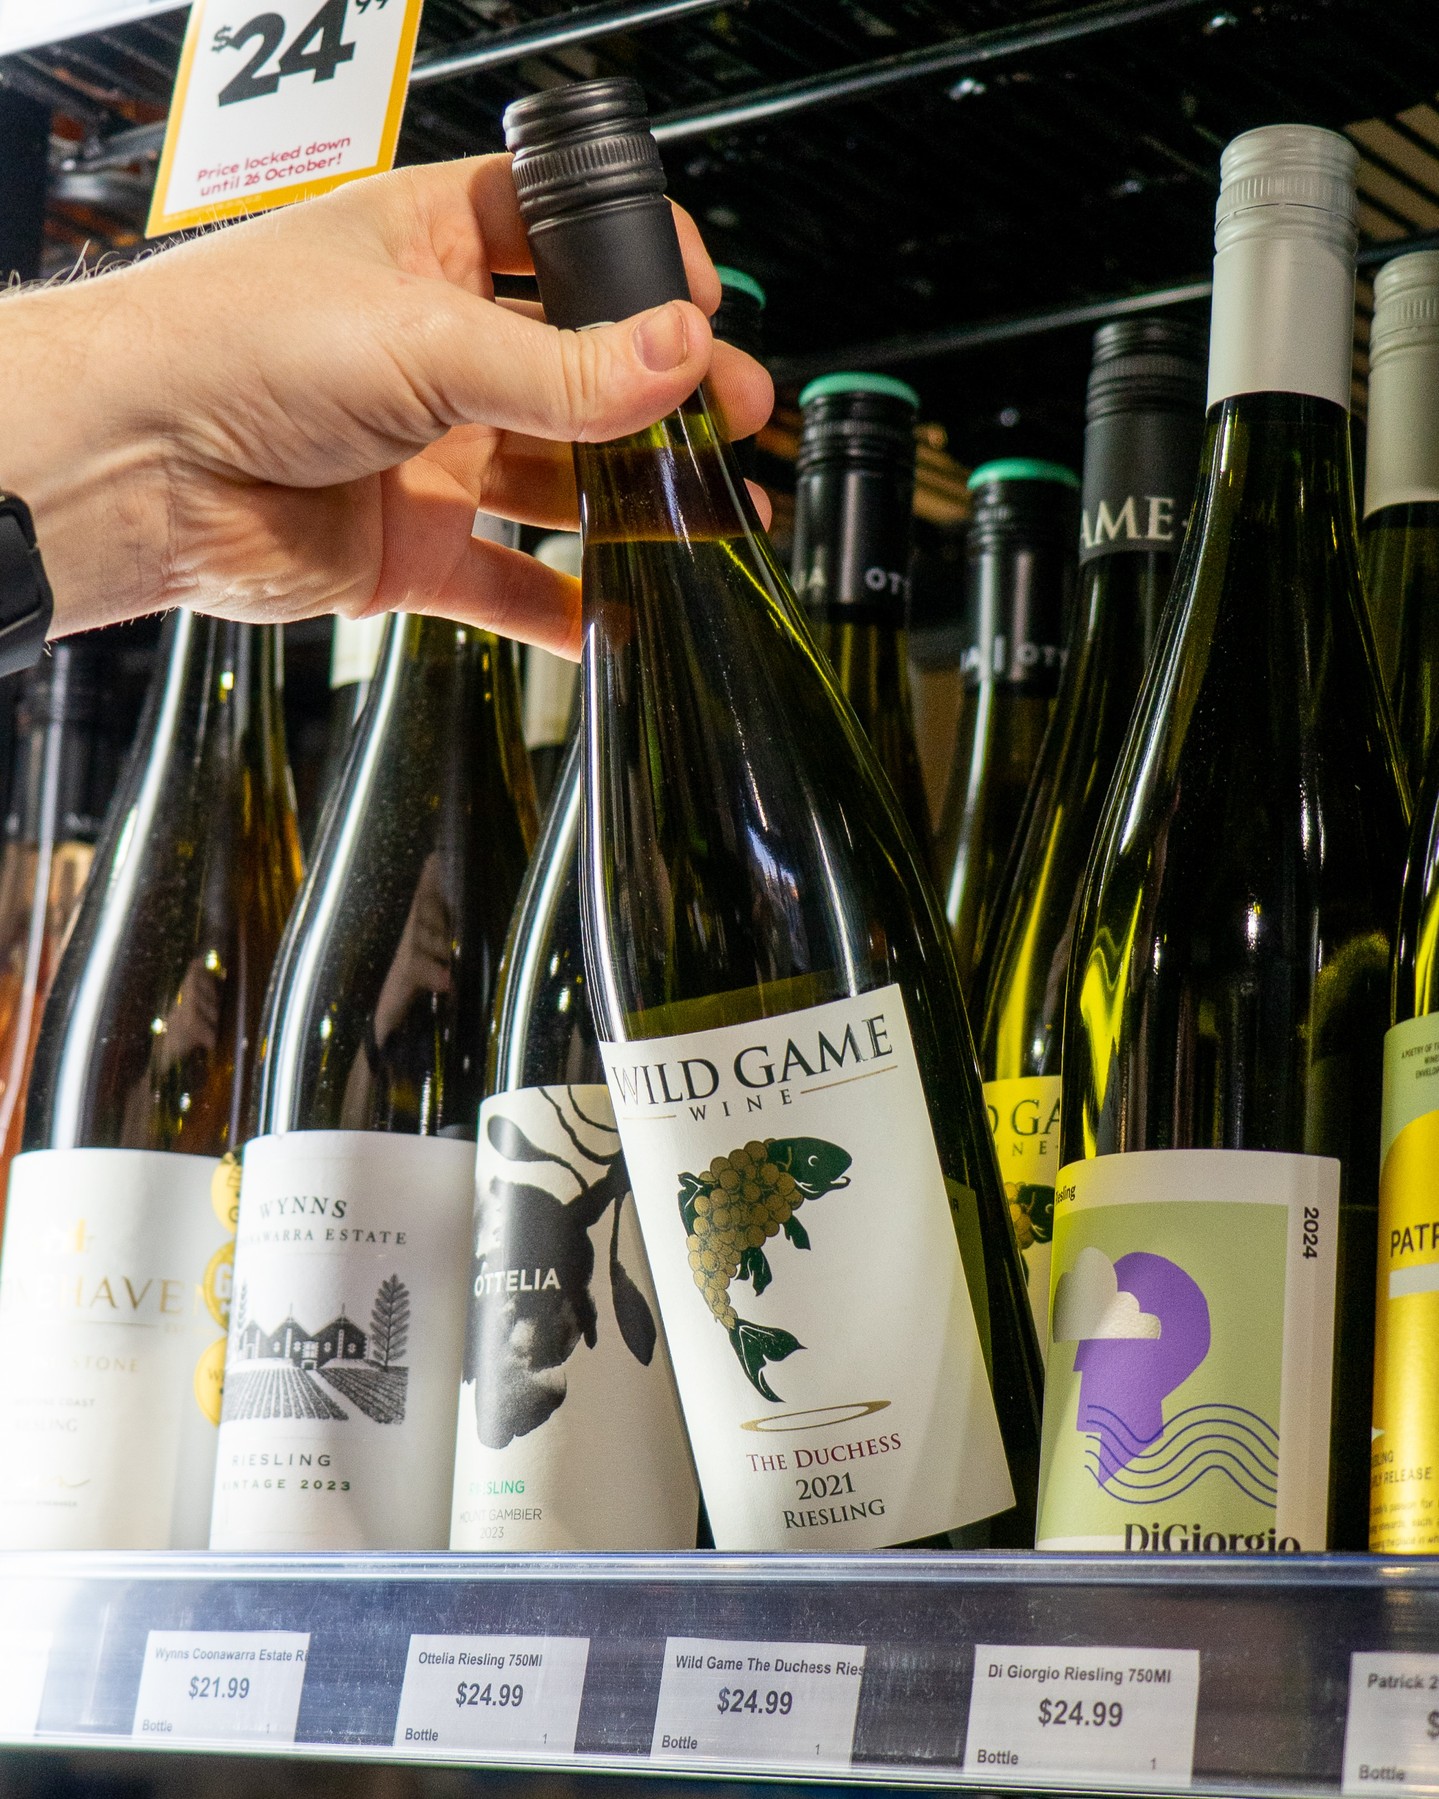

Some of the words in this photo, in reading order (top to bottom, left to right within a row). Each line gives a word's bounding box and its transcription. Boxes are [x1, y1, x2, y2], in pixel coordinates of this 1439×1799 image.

[197, 163, 239, 182] Price
[245, 146, 302, 171] locked
[305, 136, 351, 156] down
[201, 176, 240, 197] until
[244, 170, 260, 187] 26
[265, 152, 342, 182] October!
[611, 1058, 719, 1106] WILD
[733, 1014, 893, 1089] GAME
[689, 1088, 793, 1122] WINE
[259, 1196, 347, 1219] WYNNS
[326, 1228, 407, 1245] ESTATE
[1302, 1206, 1319, 1261] 2024
[474, 1268, 561, 1297] OTTELIA
[232, 1454, 331, 1467] RIESLING
[300, 1479, 351, 1492] 2023
[796, 1472, 856, 1500] 2021
[488, 1508, 542, 1521] GAMBIER
[480, 1526, 504, 1540] 2023
[155, 1648, 189, 1662] Wynns
[192, 1648, 256, 1661] Coonawarra
[259, 1649, 293, 1661] Estate
[418, 1651, 455, 1665] Ottelia
[458, 1652, 505, 1669] Riesling
[676, 1655, 703, 1669] Wild
[706, 1656, 743, 1670] Game
[747, 1657, 770, 1671] The
[774, 1658, 832, 1675] Duchess
[988, 1664, 1003, 1678] Di
[1007, 1664, 1060, 1683] Giorgio
[1064, 1666, 1123, 1685] Riesling
[1368, 1673, 1424, 1689] Patrick
[188, 1676, 250, 1700] $21.99
[455, 1681, 524, 1708] $24.99
[717, 1686, 793, 1715] $24.99
[1038, 1697, 1123, 1727] $24.99
[142, 1719, 173, 1733] Bottle
[405, 1727, 439, 1742] Bottle
[543, 1733, 548, 1744] 1
[661, 1734, 698, 1750] Bottle
[815, 1744, 821, 1755] 1
[977, 1749, 1019, 1765] Bottle
[1150, 1757, 1157, 1770] 1
[1359, 1763, 1405, 1781] Bottle
